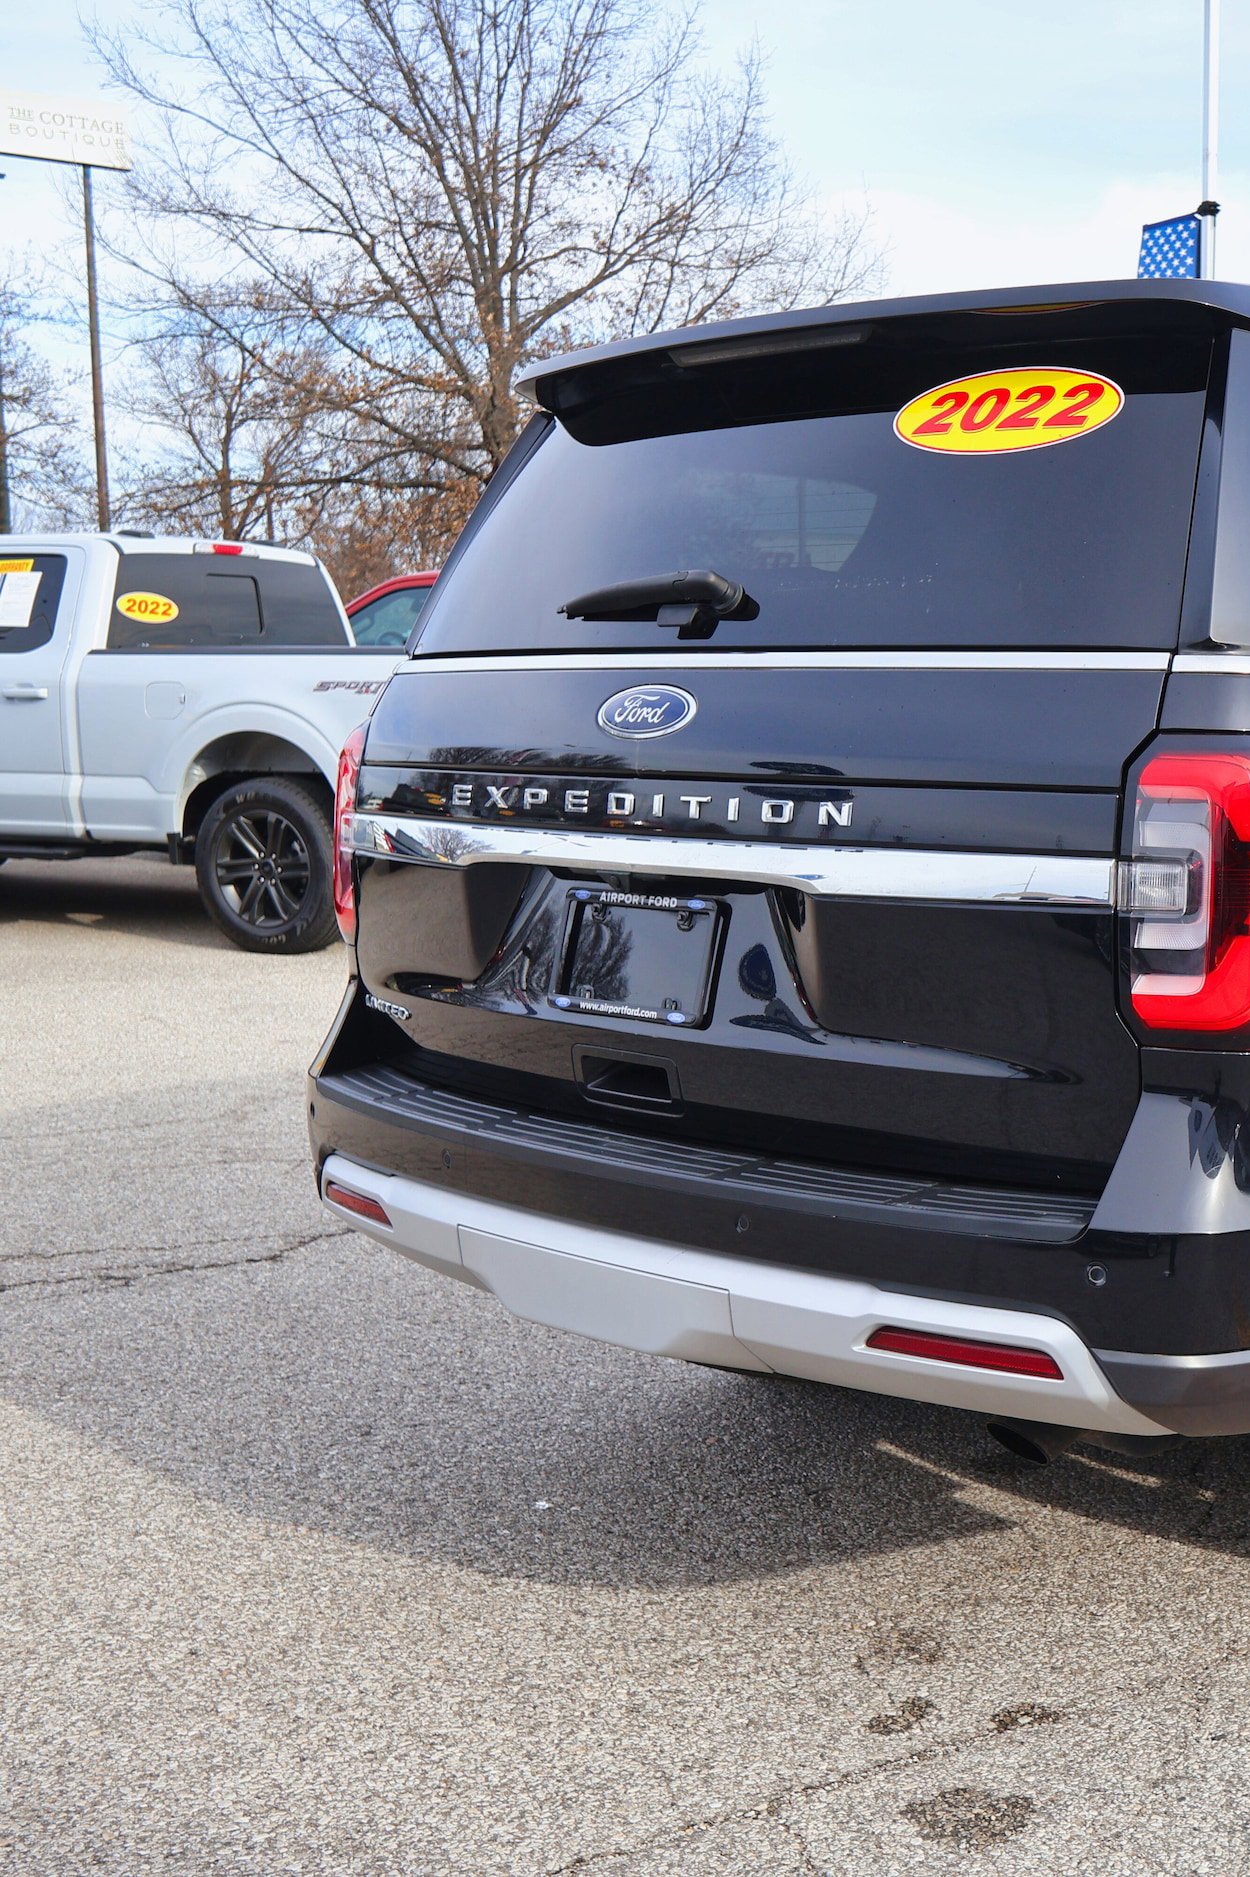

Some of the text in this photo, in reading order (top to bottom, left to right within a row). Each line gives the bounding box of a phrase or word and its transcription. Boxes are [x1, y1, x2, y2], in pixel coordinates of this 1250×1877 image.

[8, 107, 125, 135] THE COTTAGE
[8, 122, 126, 150] BOUTIQUE
[911, 382, 1105, 438] 2022
[125, 597, 173, 617] 2022
[614, 693, 671, 723] Ford
[451, 783, 854, 827] EXPEDITION
[599, 891, 646, 905] AIRPORT
[648, 896, 678, 908] FORD
[579, 1001, 658, 1019] www.airportford.com
